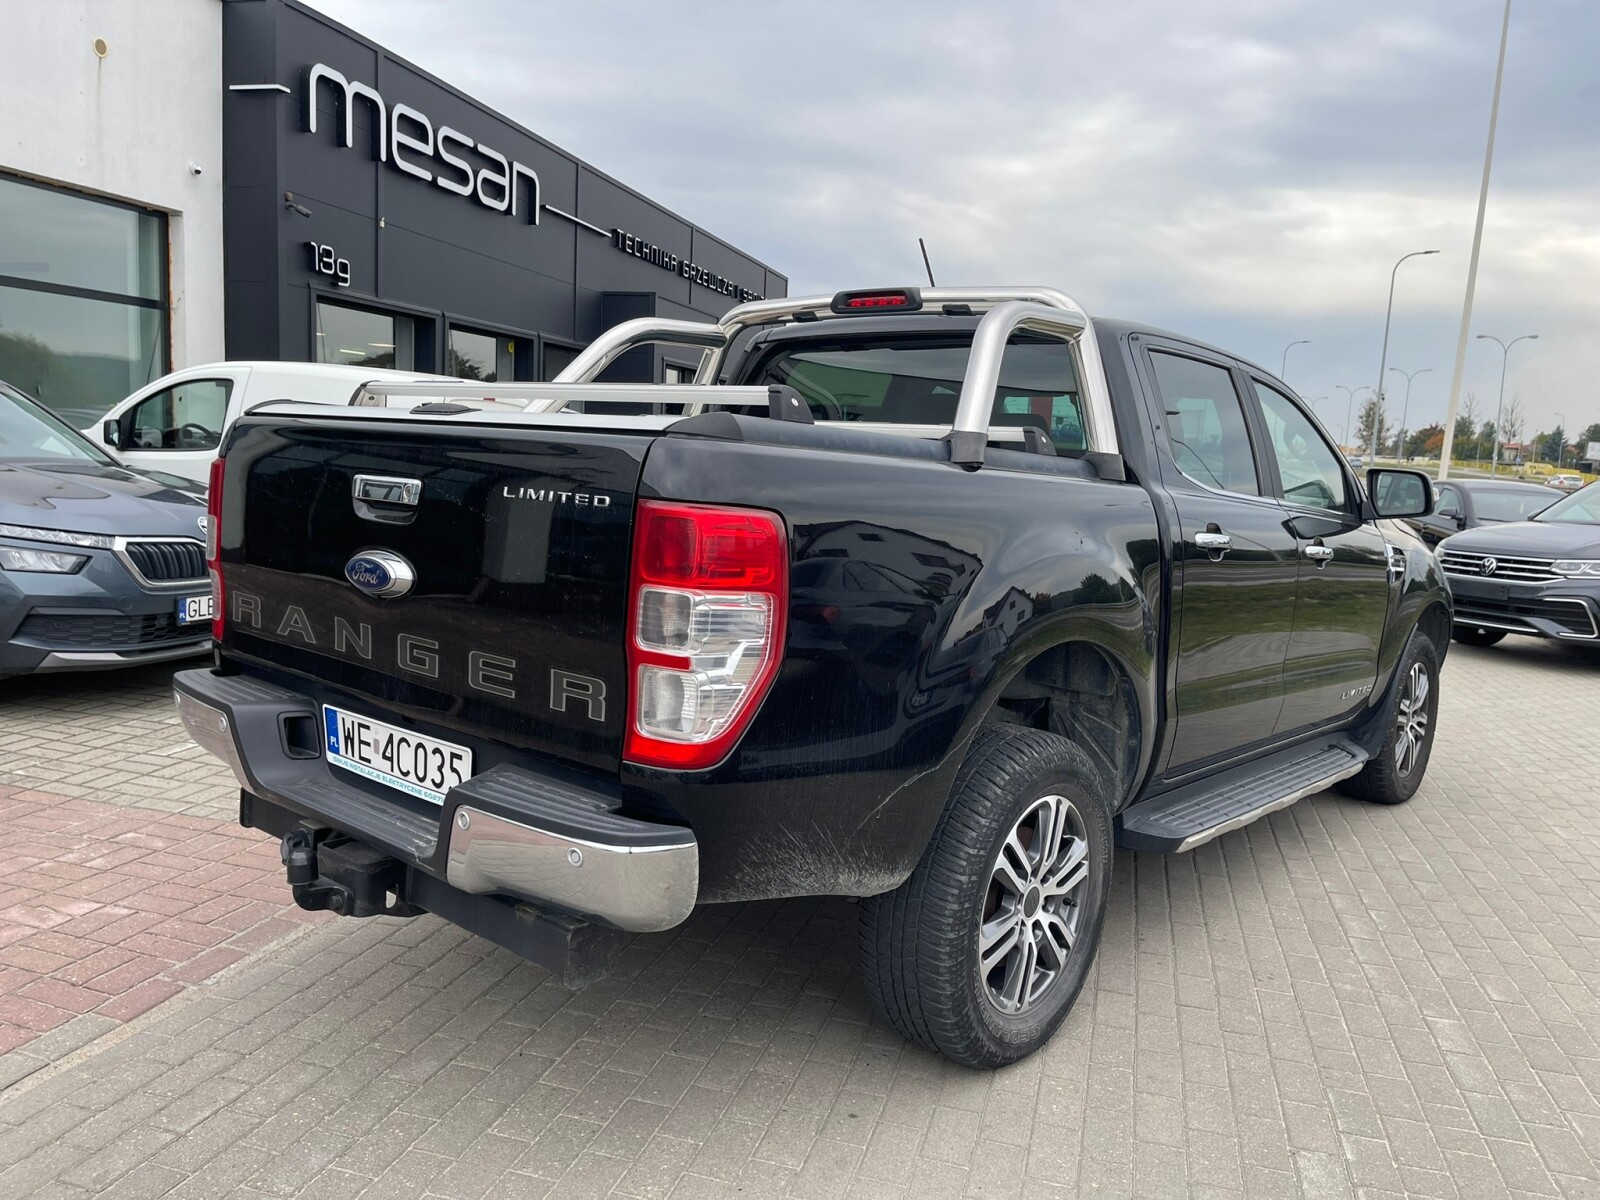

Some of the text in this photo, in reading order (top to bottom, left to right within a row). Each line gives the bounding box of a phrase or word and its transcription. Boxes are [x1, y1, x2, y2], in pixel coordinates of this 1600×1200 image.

[309, 63, 540, 225] mesan
[310, 241, 351, 287] 13g
[616, 228, 678, 272] TECHNIKA
[682, 260, 734, 296] GRZEWCZA
[502, 486, 611, 508] LIMITED
[352, 561, 380, 585] Ford
[232, 590, 607, 722] RANGER
[1341, 684, 1373, 699] LIMITED
[330, 717, 463, 789] PL WE 4C035
[382, 775, 423, 796] ELEKTRYCZNE
